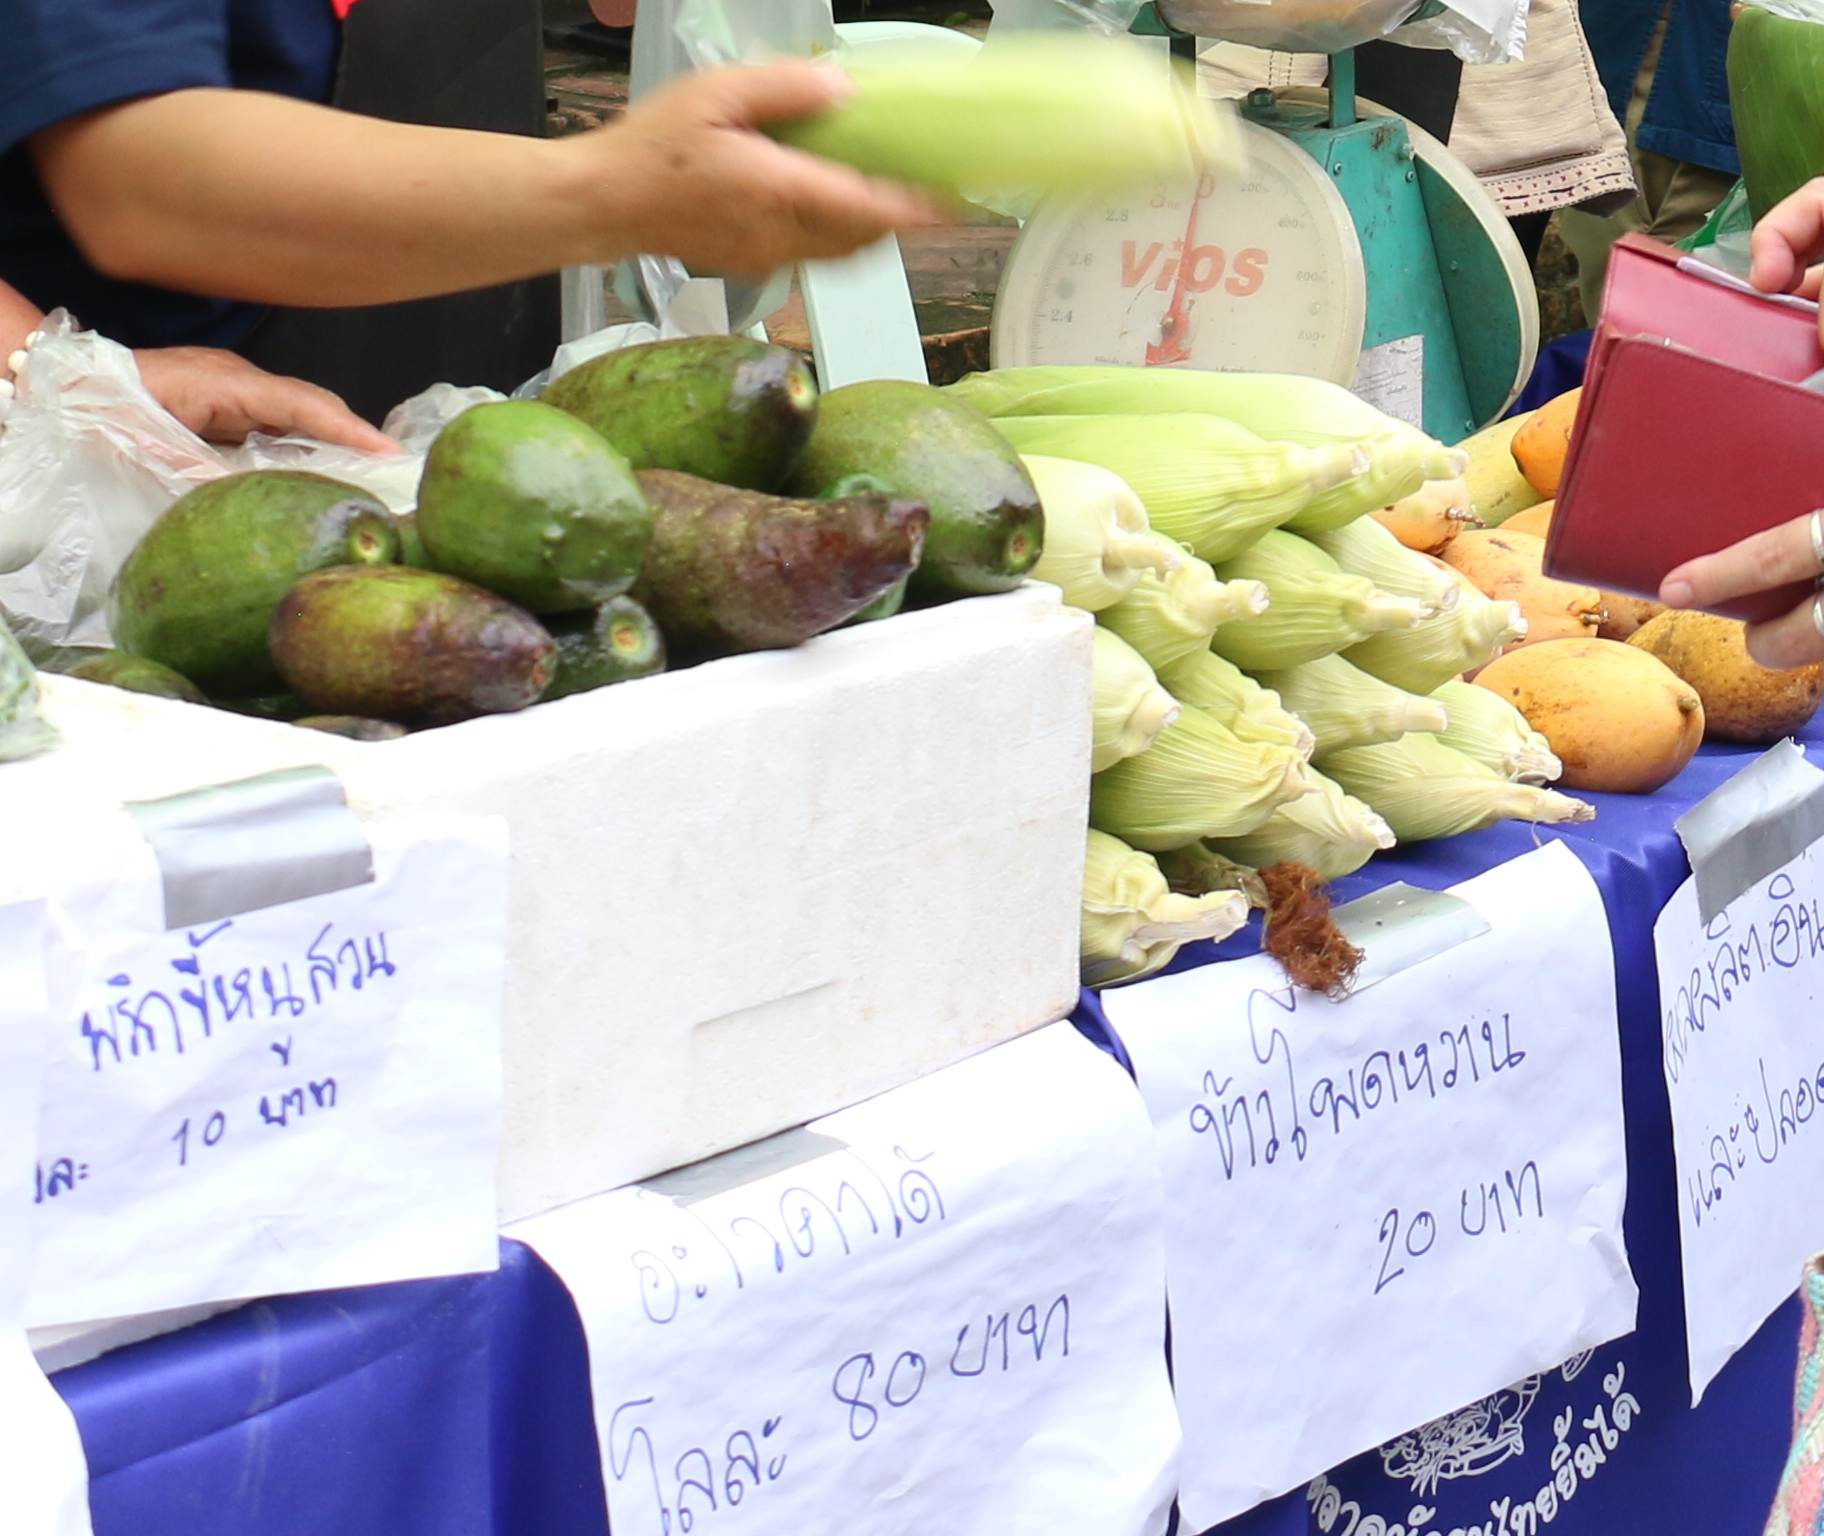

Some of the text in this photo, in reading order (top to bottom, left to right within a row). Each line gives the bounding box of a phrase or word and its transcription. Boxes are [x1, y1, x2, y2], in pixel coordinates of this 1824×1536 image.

[171, 1110, 226, 1167] 10
[259, 1077, 338, 1127] บาท
[1374, 1160, 1543, 1295] 20 บาท
[832, 1350, 926, 1442] 80
[949, 1294, 1070, 1378] บาท
